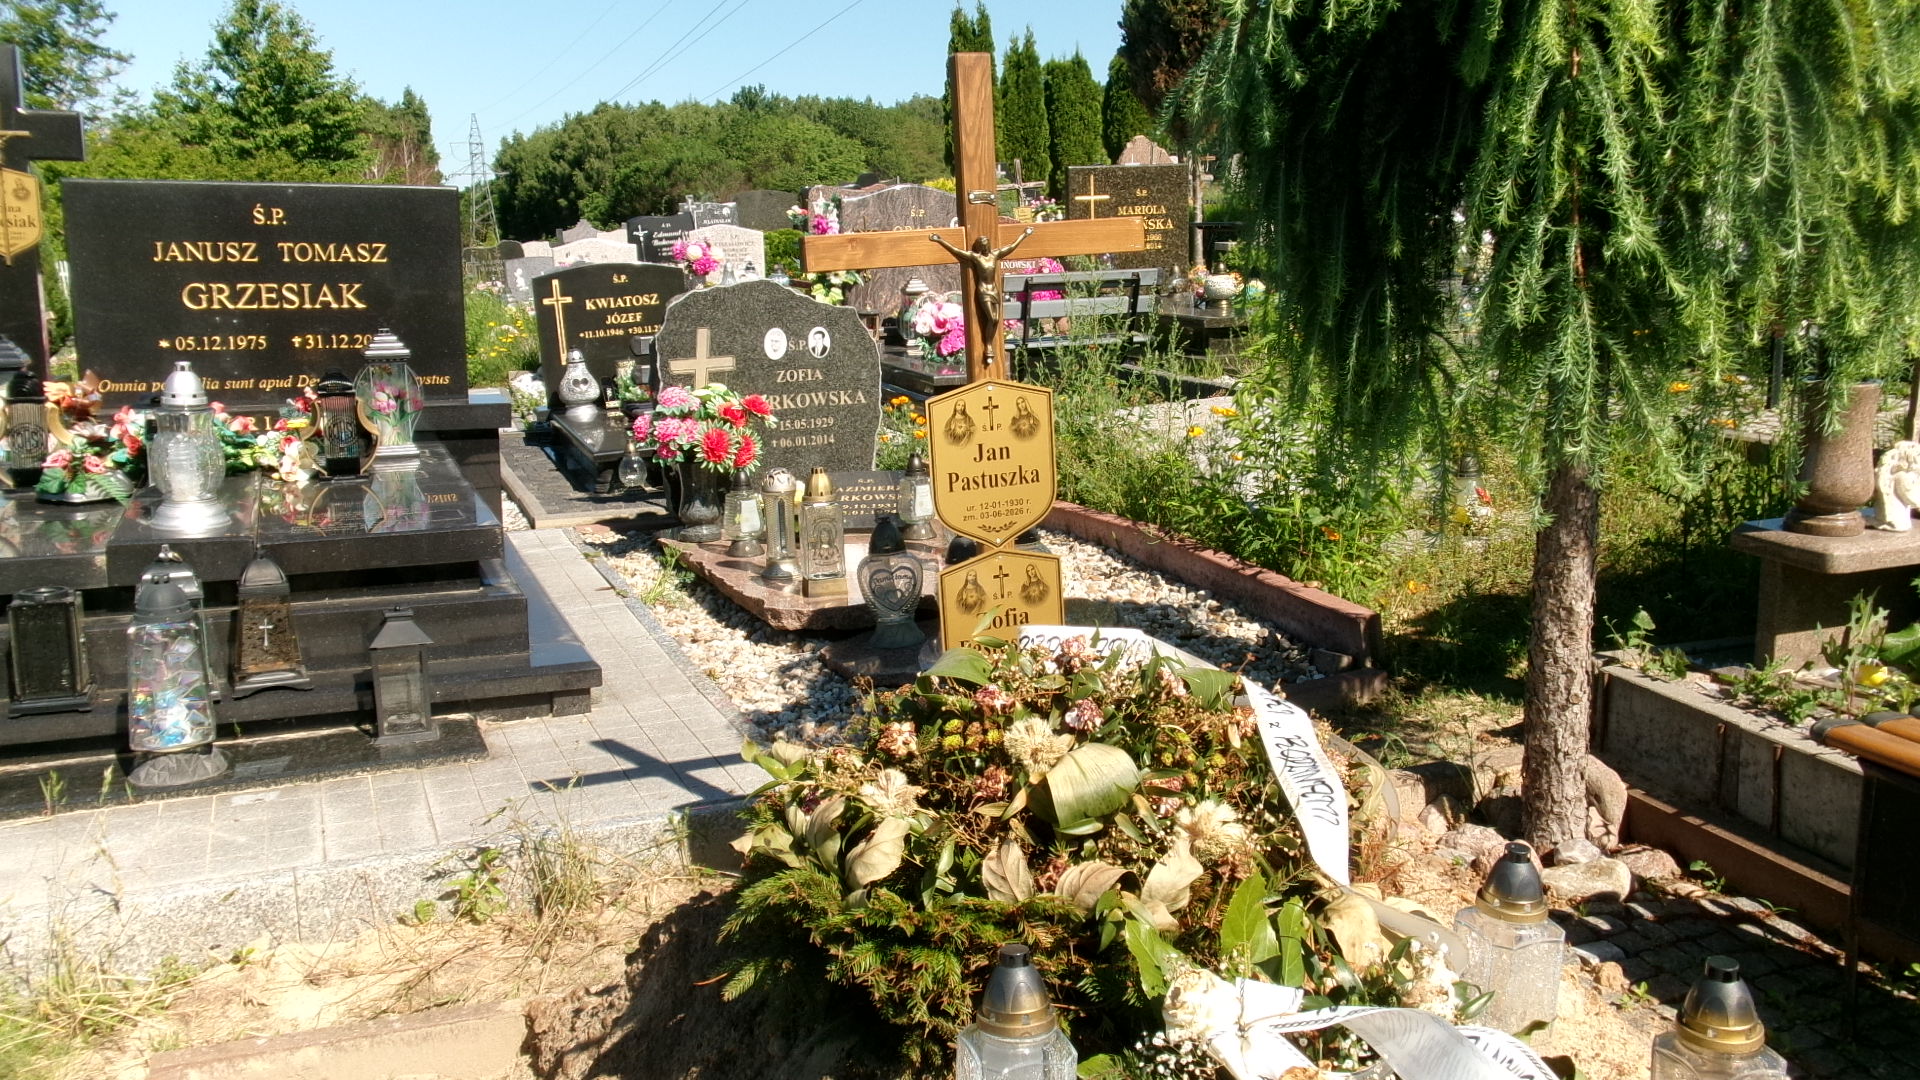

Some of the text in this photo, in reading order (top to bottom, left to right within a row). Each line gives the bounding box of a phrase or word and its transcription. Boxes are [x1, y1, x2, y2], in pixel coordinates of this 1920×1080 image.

[252, 203, 287, 225] Ś.P.
[1118, 205, 1166, 215] MARIOLA
[1143, 216, 1174, 230] ŃSKA
[153, 241, 389, 263] JANUSZ TOMASZ
[1000, 260, 1036, 269] INOWSKI
[181, 282, 368, 309] GRZESIAK
[585, 293, 660, 311] KWIATOSZ
[605, 311, 643, 325] JÓZEF
[175, 333, 375, 351] 05.12.1975 31.12.20
[776, 368, 823, 383] ZOFIA
[98, 379, 146, 393] Omnia
[224, 378, 255, 390] sunt
[259, 374, 293, 392] apud
[768, 389, 867, 411] RKOWSKA
[780, 416, 834, 431] 15.05.1929
[780, 433, 835, 448] 06.01.2014
[973, 443, 1011, 463] Jan
[947, 465, 1040, 493] Pastuszka
[842, 502, 897, 510] 9.10.1931
[966, 504, 977, 513] ur.
[979, 498, 1024, 511] 12-01-1930
[963, 514, 978, 522] zm.
